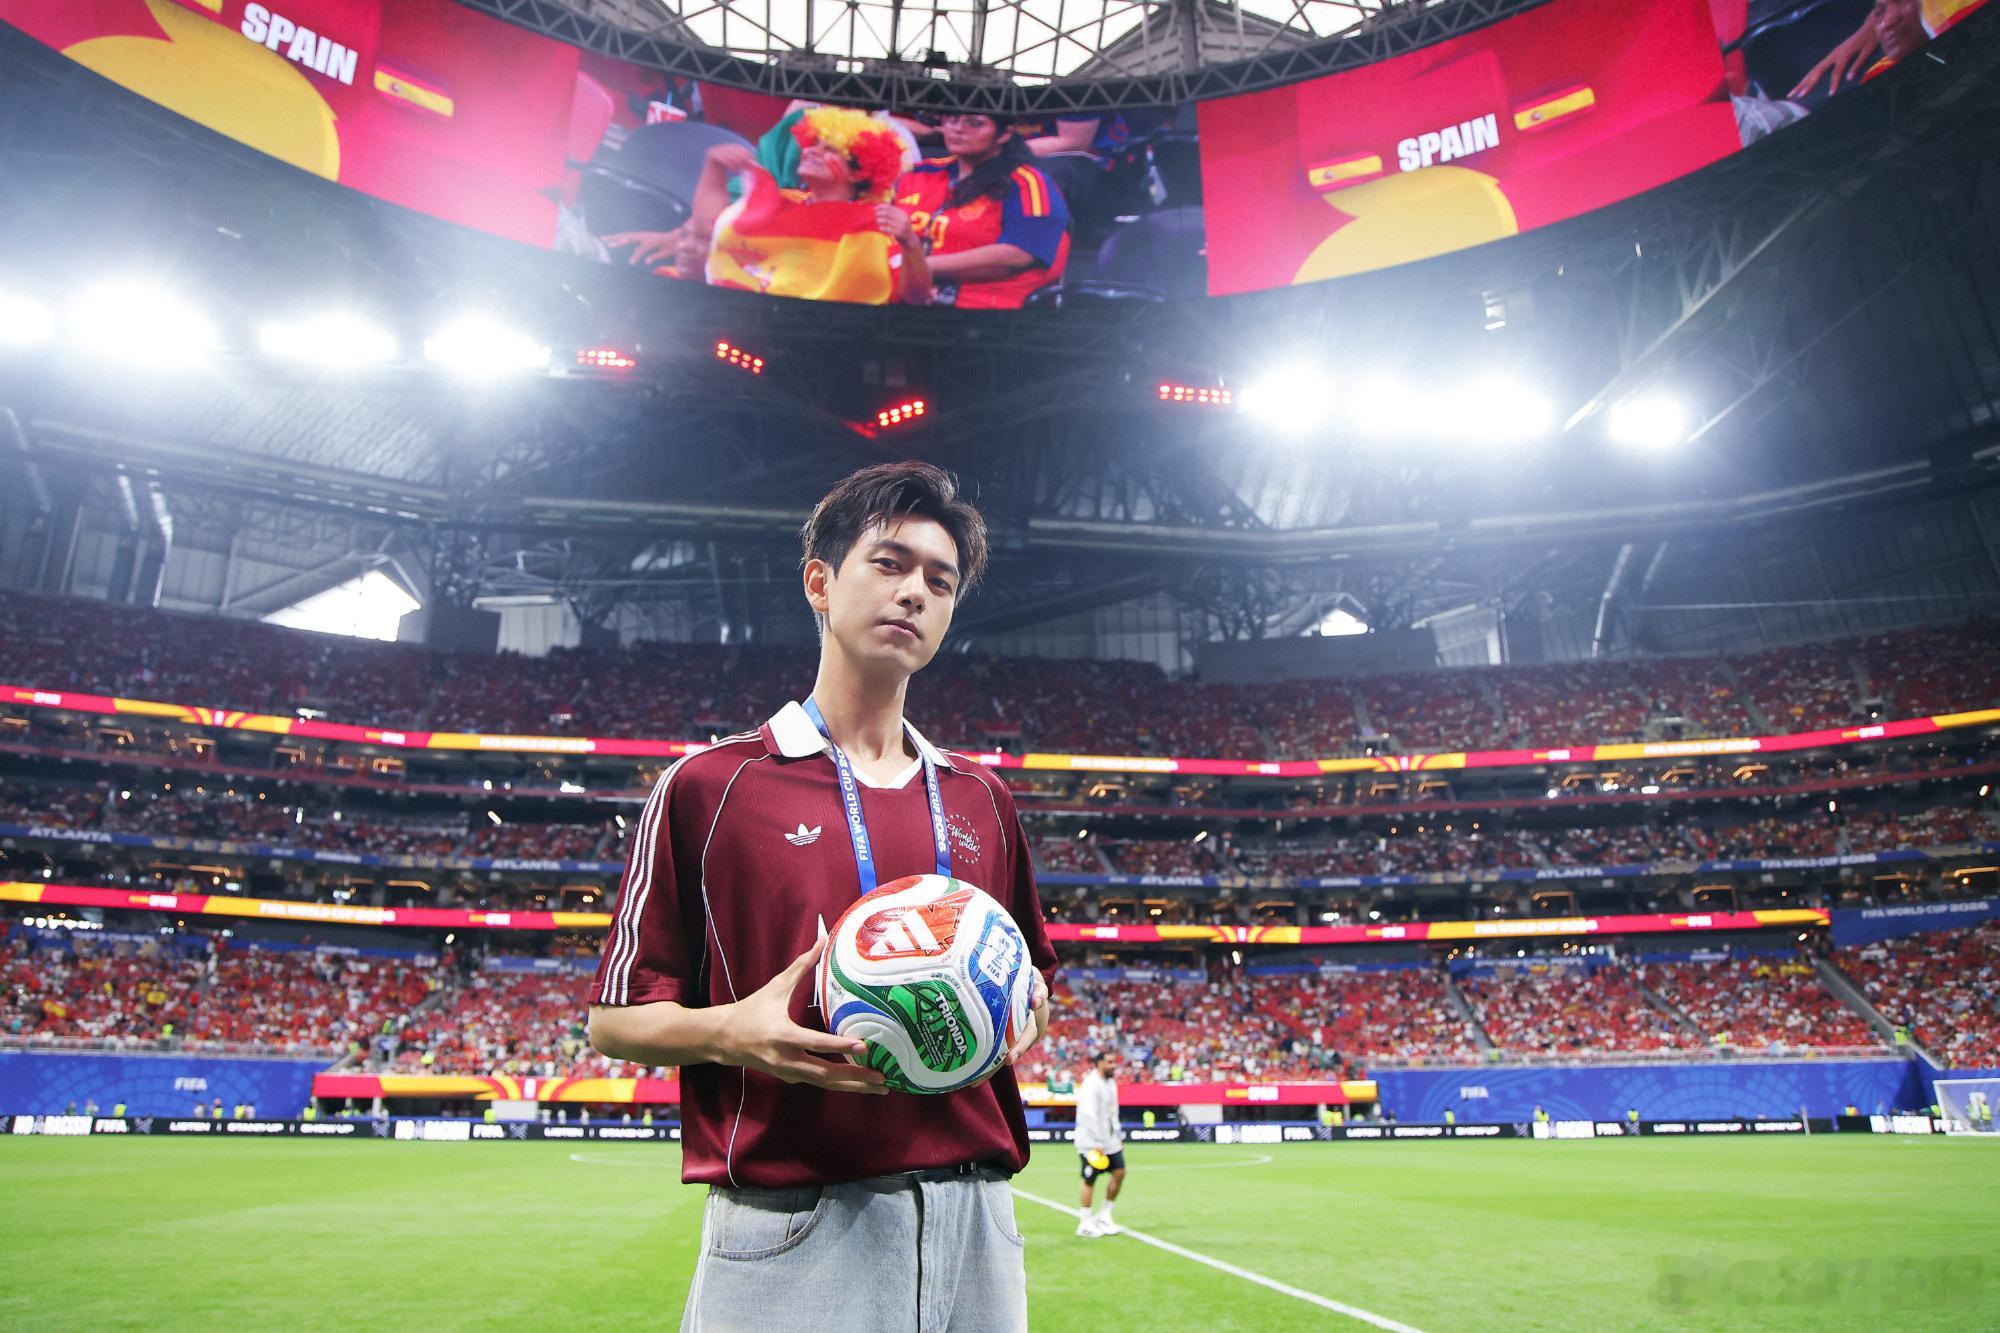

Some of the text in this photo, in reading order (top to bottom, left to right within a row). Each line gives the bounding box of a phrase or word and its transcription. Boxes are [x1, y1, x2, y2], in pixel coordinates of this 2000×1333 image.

[241, 2, 358, 86] SPAIN
[1397, 113, 1499, 172] SPAIN
[841, 769, 853, 791] CUP
[927, 762, 936, 792] ORLD
[930, 791, 940, 813] CUP
[846, 793, 865, 836] WORLD
[28, 826, 112, 842] ATLANTA
[856, 836, 869, 861] FIFA
[491, 859, 560, 871] ATLANTA
[1536, 866, 1603, 879] ATLANTA
[1140, 876, 1203, 886] ATLANTA
[1862, 909, 1885, 919] FIFA
[1886, 905, 1927, 917] WORLD
[1928, 904, 1948, 914] CUP
[986, 964, 1000, 979] FIFA
[935, 991, 968, 1056] TRIONDA
[174, 1077, 208, 1091] FIFA
[1460, 1086, 1489, 1099] FIFA
